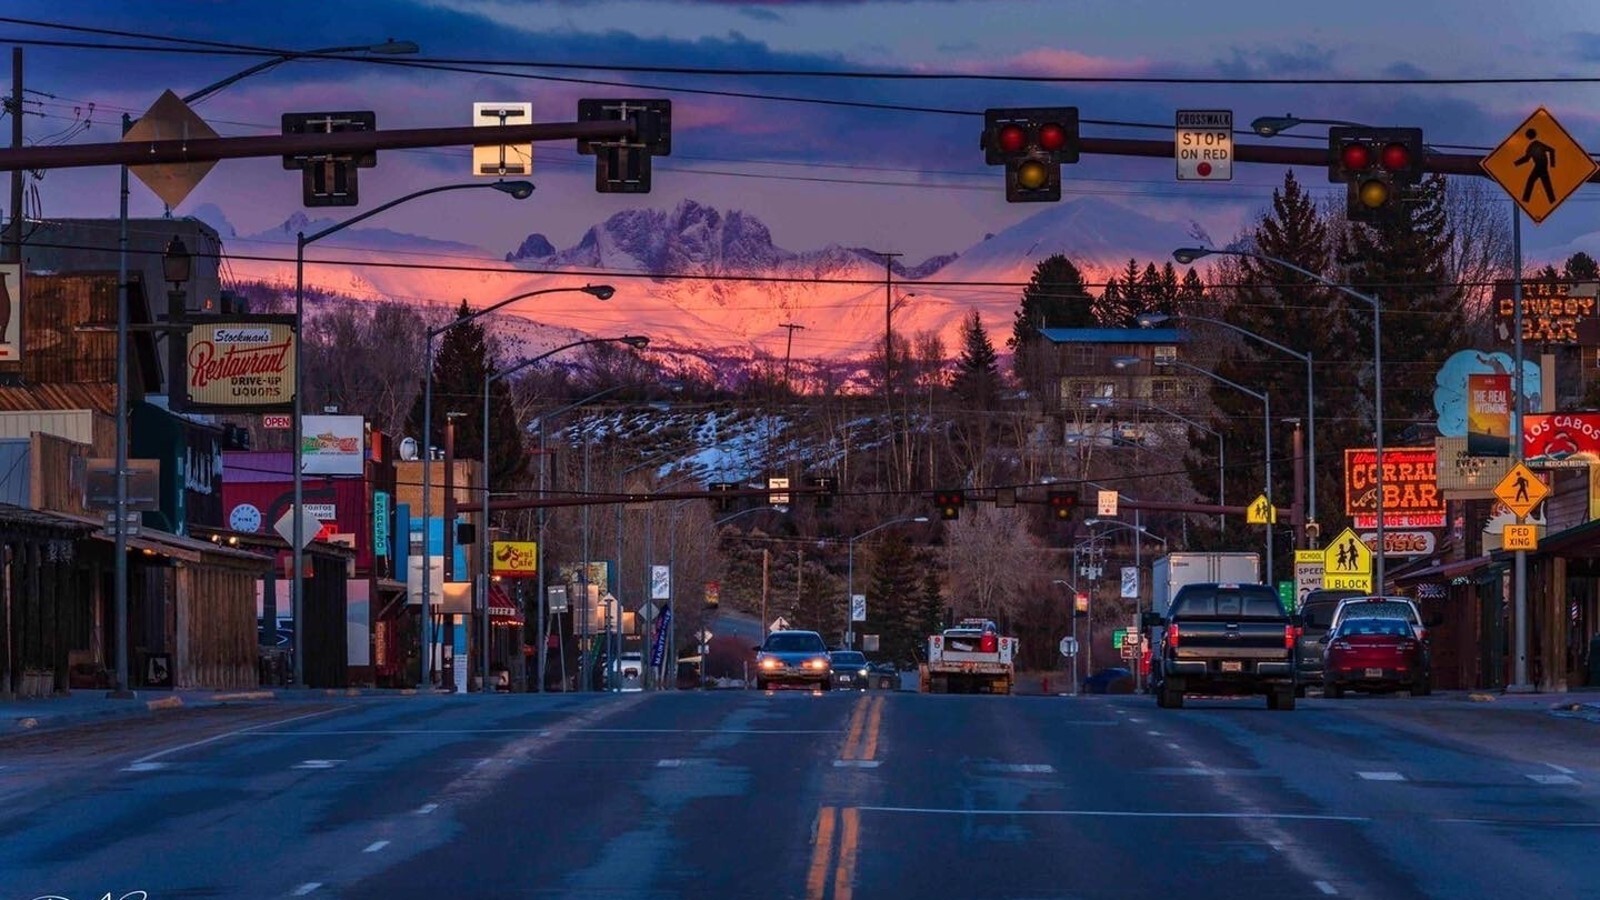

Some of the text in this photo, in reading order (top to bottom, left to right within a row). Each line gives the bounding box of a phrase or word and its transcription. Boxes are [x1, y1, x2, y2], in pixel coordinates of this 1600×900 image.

[1179, 113, 1230, 125] CROSSWALK
[1183, 132, 1227, 146] STOP
[1181, 149, 1228, 160] ON RED
[1522, 283, 1569, 296] THE
[1499, 298, 1595, 315] COWBOY
[1521, 318, 1578, 340] BAR
[215, 330, 269, 342] Stockman's
[189, 336, 292, 387] Restaurant
[231, 377, 282, 386] DRIVE-UP
[232, 387, 281, 396] LIQUORS
[1473, 390, 1507, 403] THE REAL
[1475, 402, 1508, 414] WYOMING
[265, 417, 290, 427] OPEN
[1524, 415, 1600, 444] LOS CABOS
[1352, 462, 1437, 490] CORRAL
[1382, 484, 1438, 508] BAR
[1407, 515, 1442, 526] GOODS
[1511, 528, 1529, 537] PED
[1510, 538, 1530, 547] XING
[511, 548, 533, 560] Soul
[1300, 552, 1322, 560] SCHOOL
[1334, 579, 1368, 589] BLOCK
